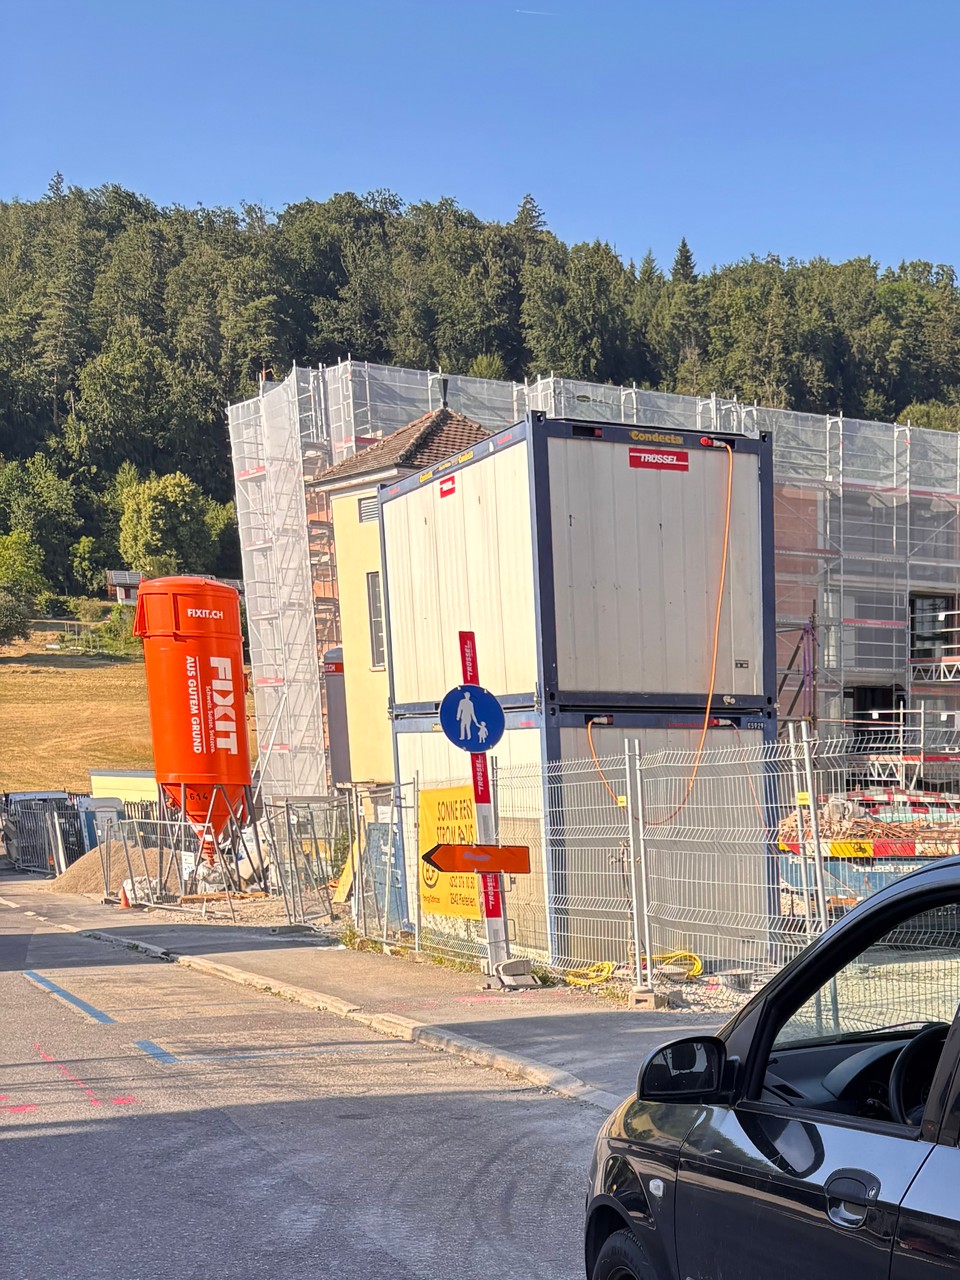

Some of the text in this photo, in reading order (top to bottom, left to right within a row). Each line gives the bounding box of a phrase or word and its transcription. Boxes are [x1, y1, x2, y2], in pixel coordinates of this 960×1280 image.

[630, 430, 684, 444] Condecta
[187, 608, 223, 619] FIXIT.CH
[186, 655, 202, 754] AUS GUTEM GRUND
[210, 657, 238, 755] FIXIT
